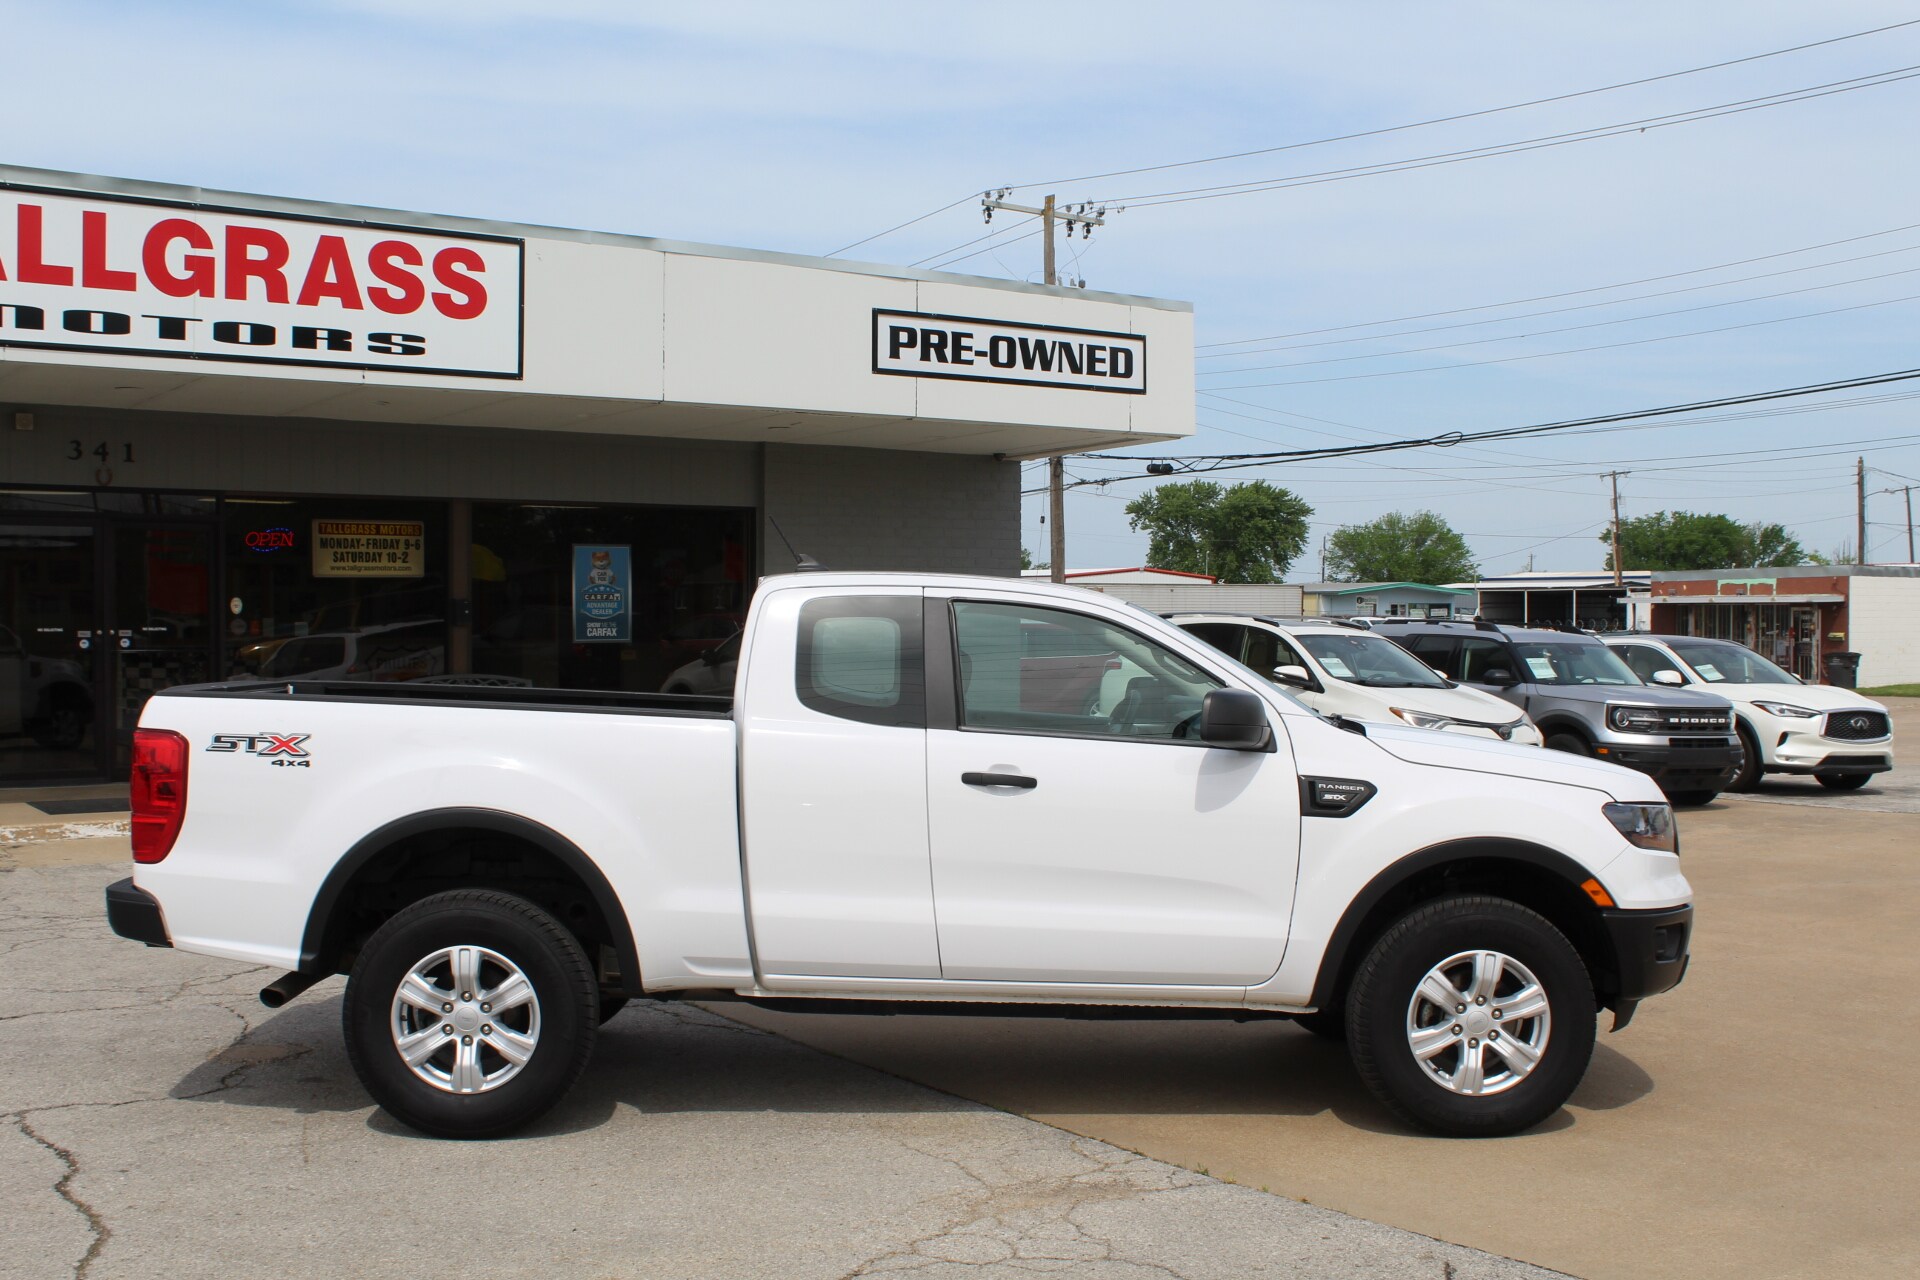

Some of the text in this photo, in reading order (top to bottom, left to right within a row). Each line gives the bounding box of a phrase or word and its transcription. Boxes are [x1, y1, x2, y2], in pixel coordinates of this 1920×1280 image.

[0, 203, 488, 320] LLGRASS
[888, 325, 1134, 379] PRE-OWNED
[320, 523, 420, 536] TALLGRASS MOTORS
[245, 531, 295, 547] OPEN
[319, 537, 421, 551] MONDAY-FRIDAY 9-6
[332, 551, 409, 563] SATURDAY 10-2
[586, 628, 618, 637] CARFAX
[205, 732, 312, 758] STX
[1318, 783, 1365, 791] RANGER
[1322, 793, 1347, 801] STX
